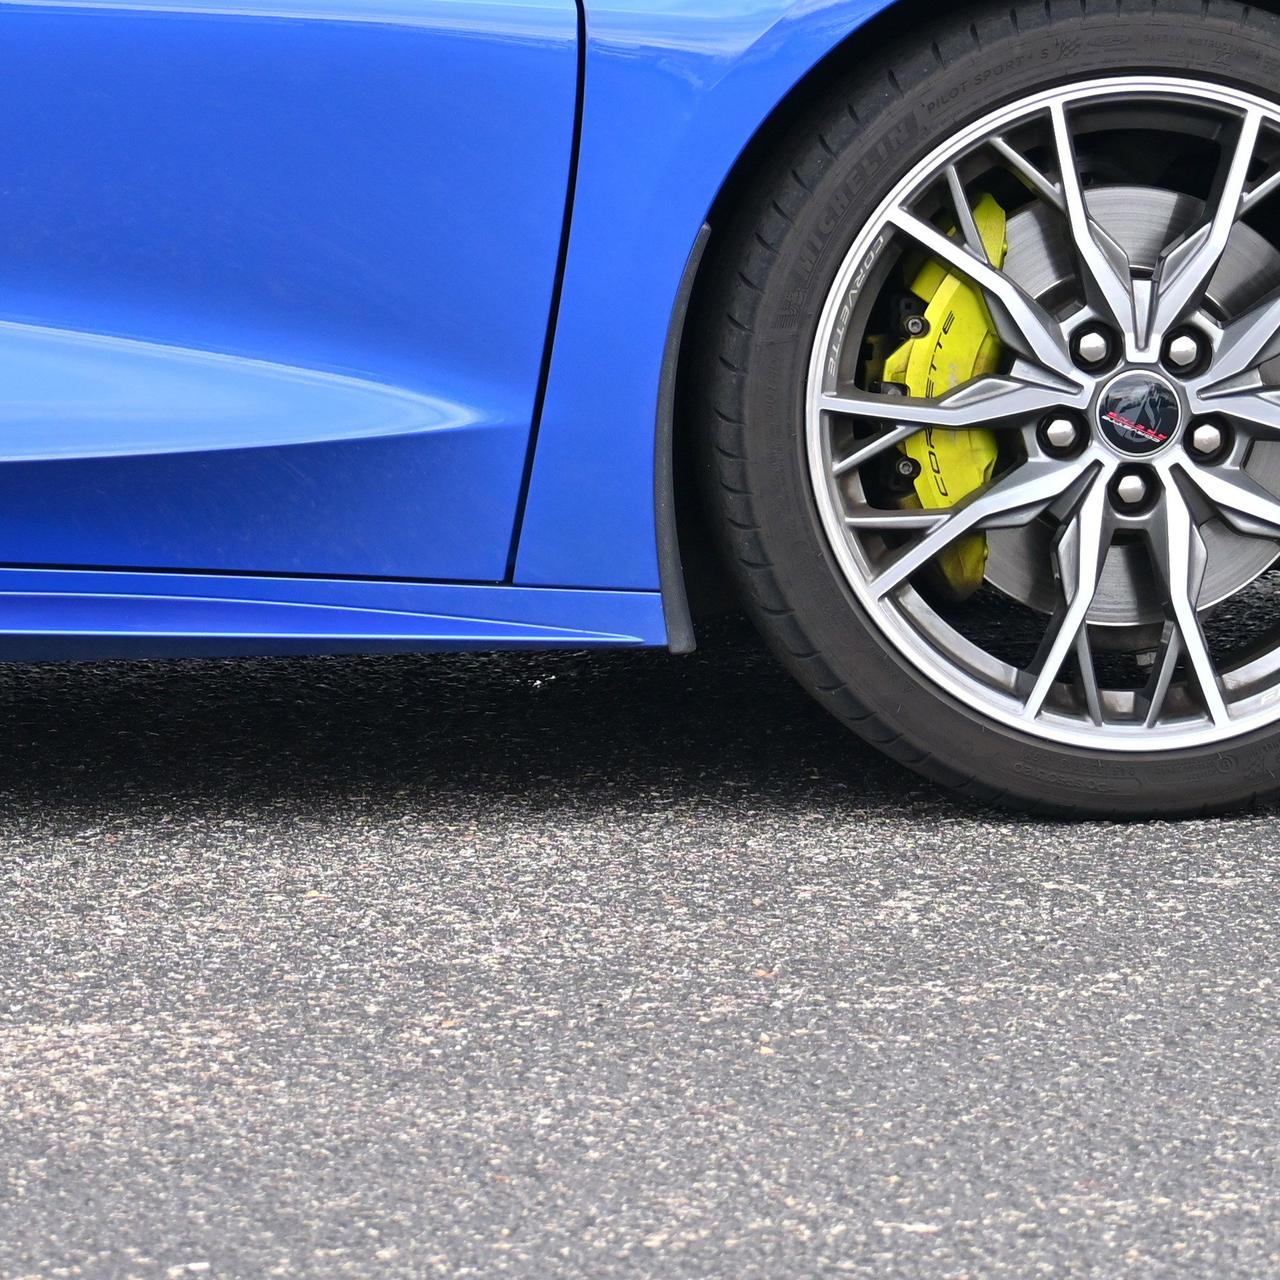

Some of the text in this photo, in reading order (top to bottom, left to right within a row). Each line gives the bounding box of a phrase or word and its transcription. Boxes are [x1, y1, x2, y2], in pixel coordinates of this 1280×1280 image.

[925, 79, 972, 114] PILOT
[973, 56, 1025, 86] SPORT
[788, 119, 915, 281] MICHELIN
[827, 234, 884, 378] CORVETTE
[926, 309, 955, 497] CORETTE
